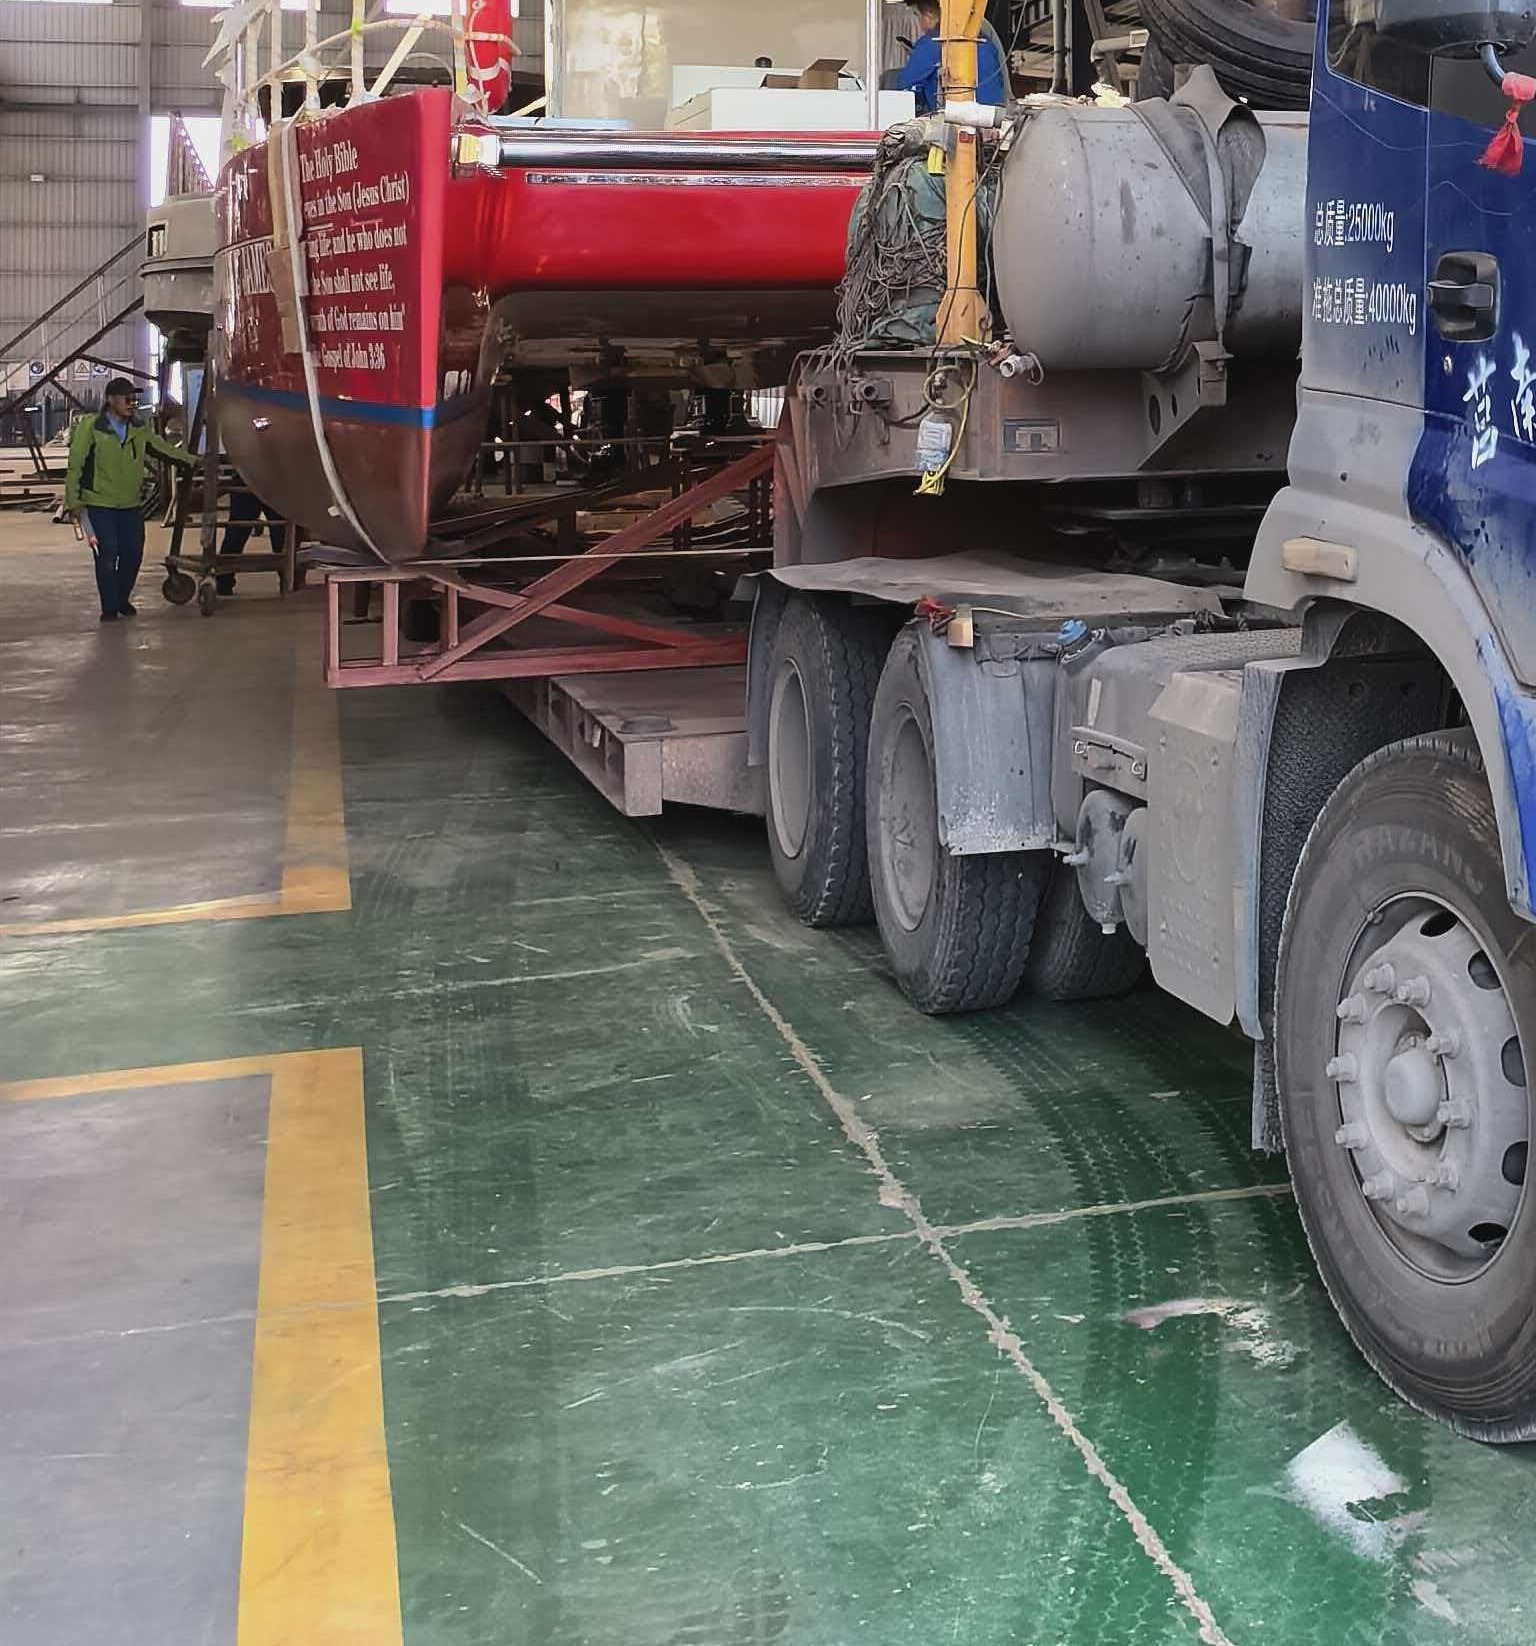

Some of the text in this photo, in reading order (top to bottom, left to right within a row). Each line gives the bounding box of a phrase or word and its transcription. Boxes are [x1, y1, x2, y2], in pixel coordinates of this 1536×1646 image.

[300, 140, 358, 183] The Holy Bible
[316, 190, 325, 216] in
[325, 189, 337, 214] the
[337, 186, 352, 212] Son
[353, 181, 379, 214] (Jesus
[380, 170, 409, 205] Christ)
[333, 227, 346, 254] and
[346, 227, 356, 253] he
[356, 223, 374, 250] who
[374, 222, 393, 248] does
[394, 220, 407, 246] not
[320, 270, 334, 295] Son
[334, 268, 351, 293] shall
[351, 269, 364, 292] not
[365, 272, 379, 291] see
[379, 263, 396, 295] life,
[334, 305, 349, 330] God
[348, 304, 378, 331] remains
[379, 311, 389, 331] on
[321, 342, 343, 373] Gospel
[351, 342, 369, 368] John
[368, 342, 386, 370] 3:36
